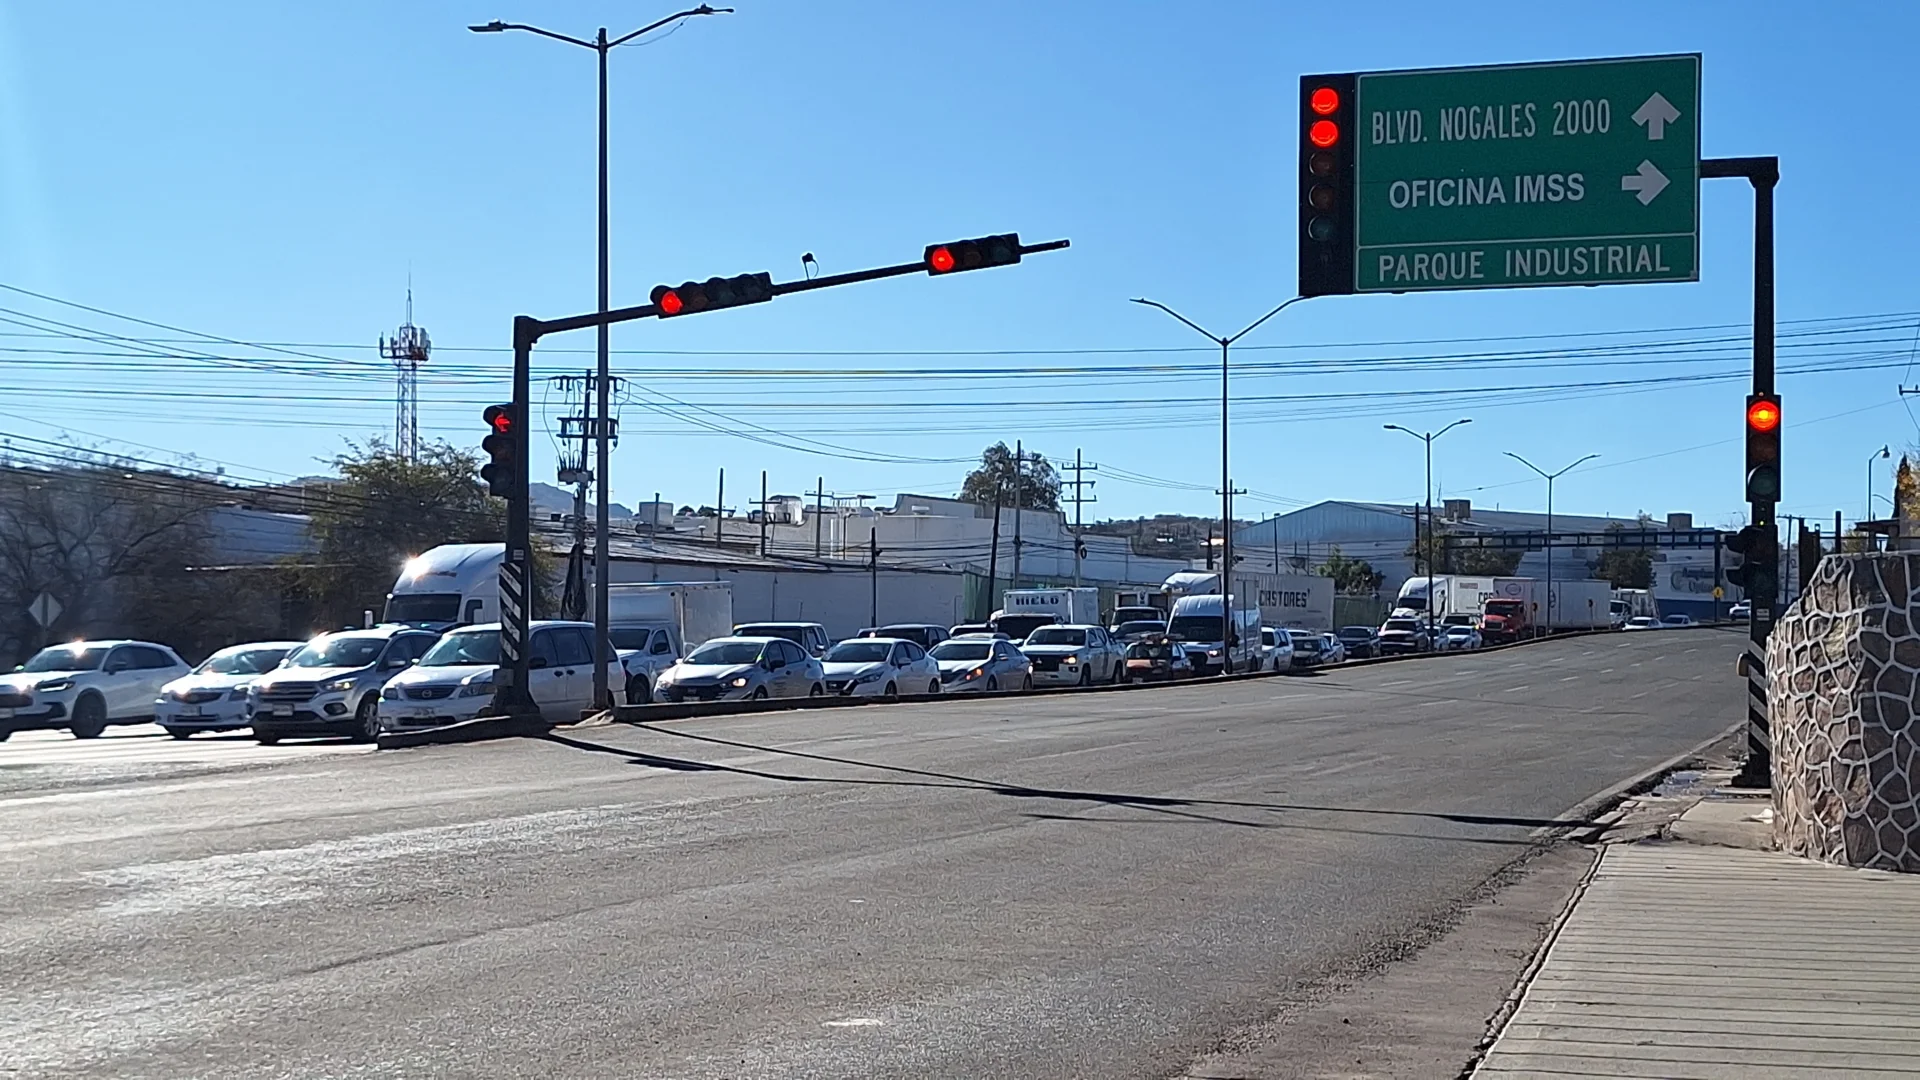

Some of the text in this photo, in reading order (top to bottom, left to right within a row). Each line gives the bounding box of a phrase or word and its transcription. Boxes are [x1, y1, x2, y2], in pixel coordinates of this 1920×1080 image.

[1372, 98, 1611, 145] BLVD. NOGALES 2000
[1389, 172, 1585, 209] OFICINA IMSS
[1378, 243, 1671, 282] PARQUE INDUSTRIAL
[1015, 595, 1059, 606] HIELO
